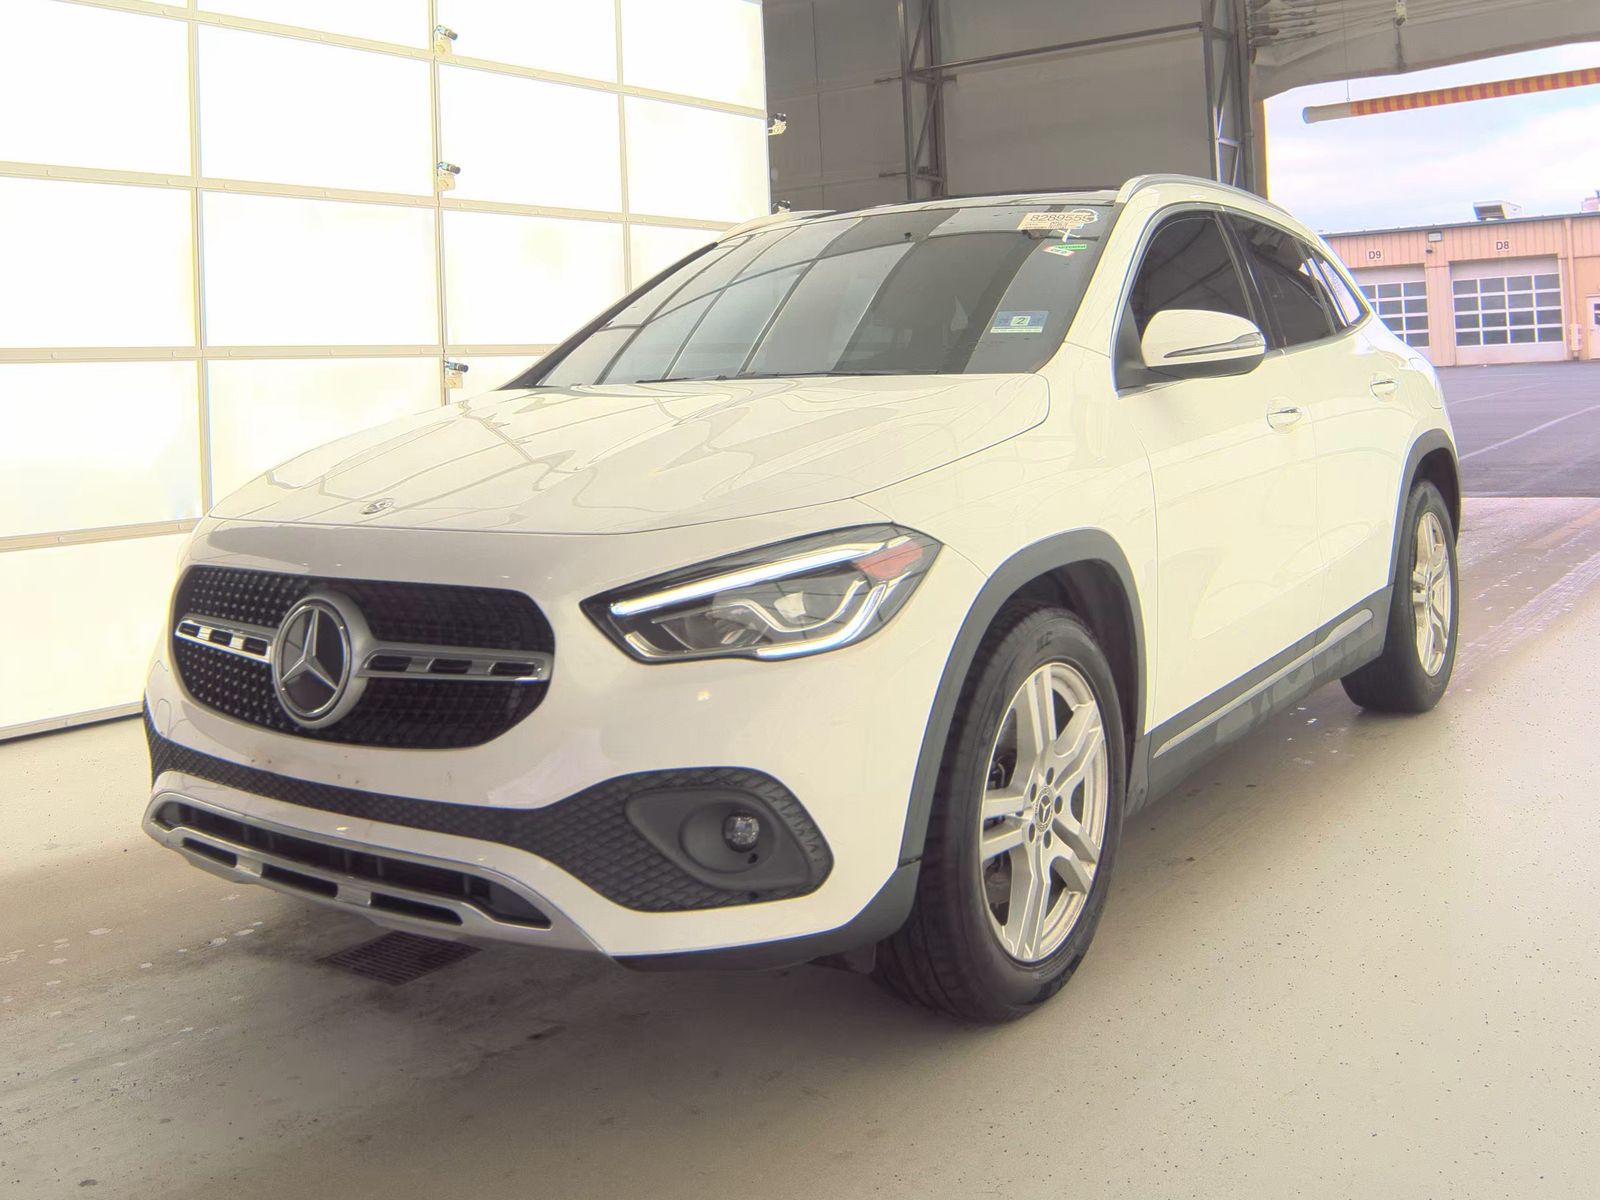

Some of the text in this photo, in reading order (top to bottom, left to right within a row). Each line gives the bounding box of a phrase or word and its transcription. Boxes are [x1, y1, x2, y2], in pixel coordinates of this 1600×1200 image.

[1496, 240, 1509, 250] D8
[1369, 250, 1381, 260] D9
[1016, 317, 1026, 325] 2
